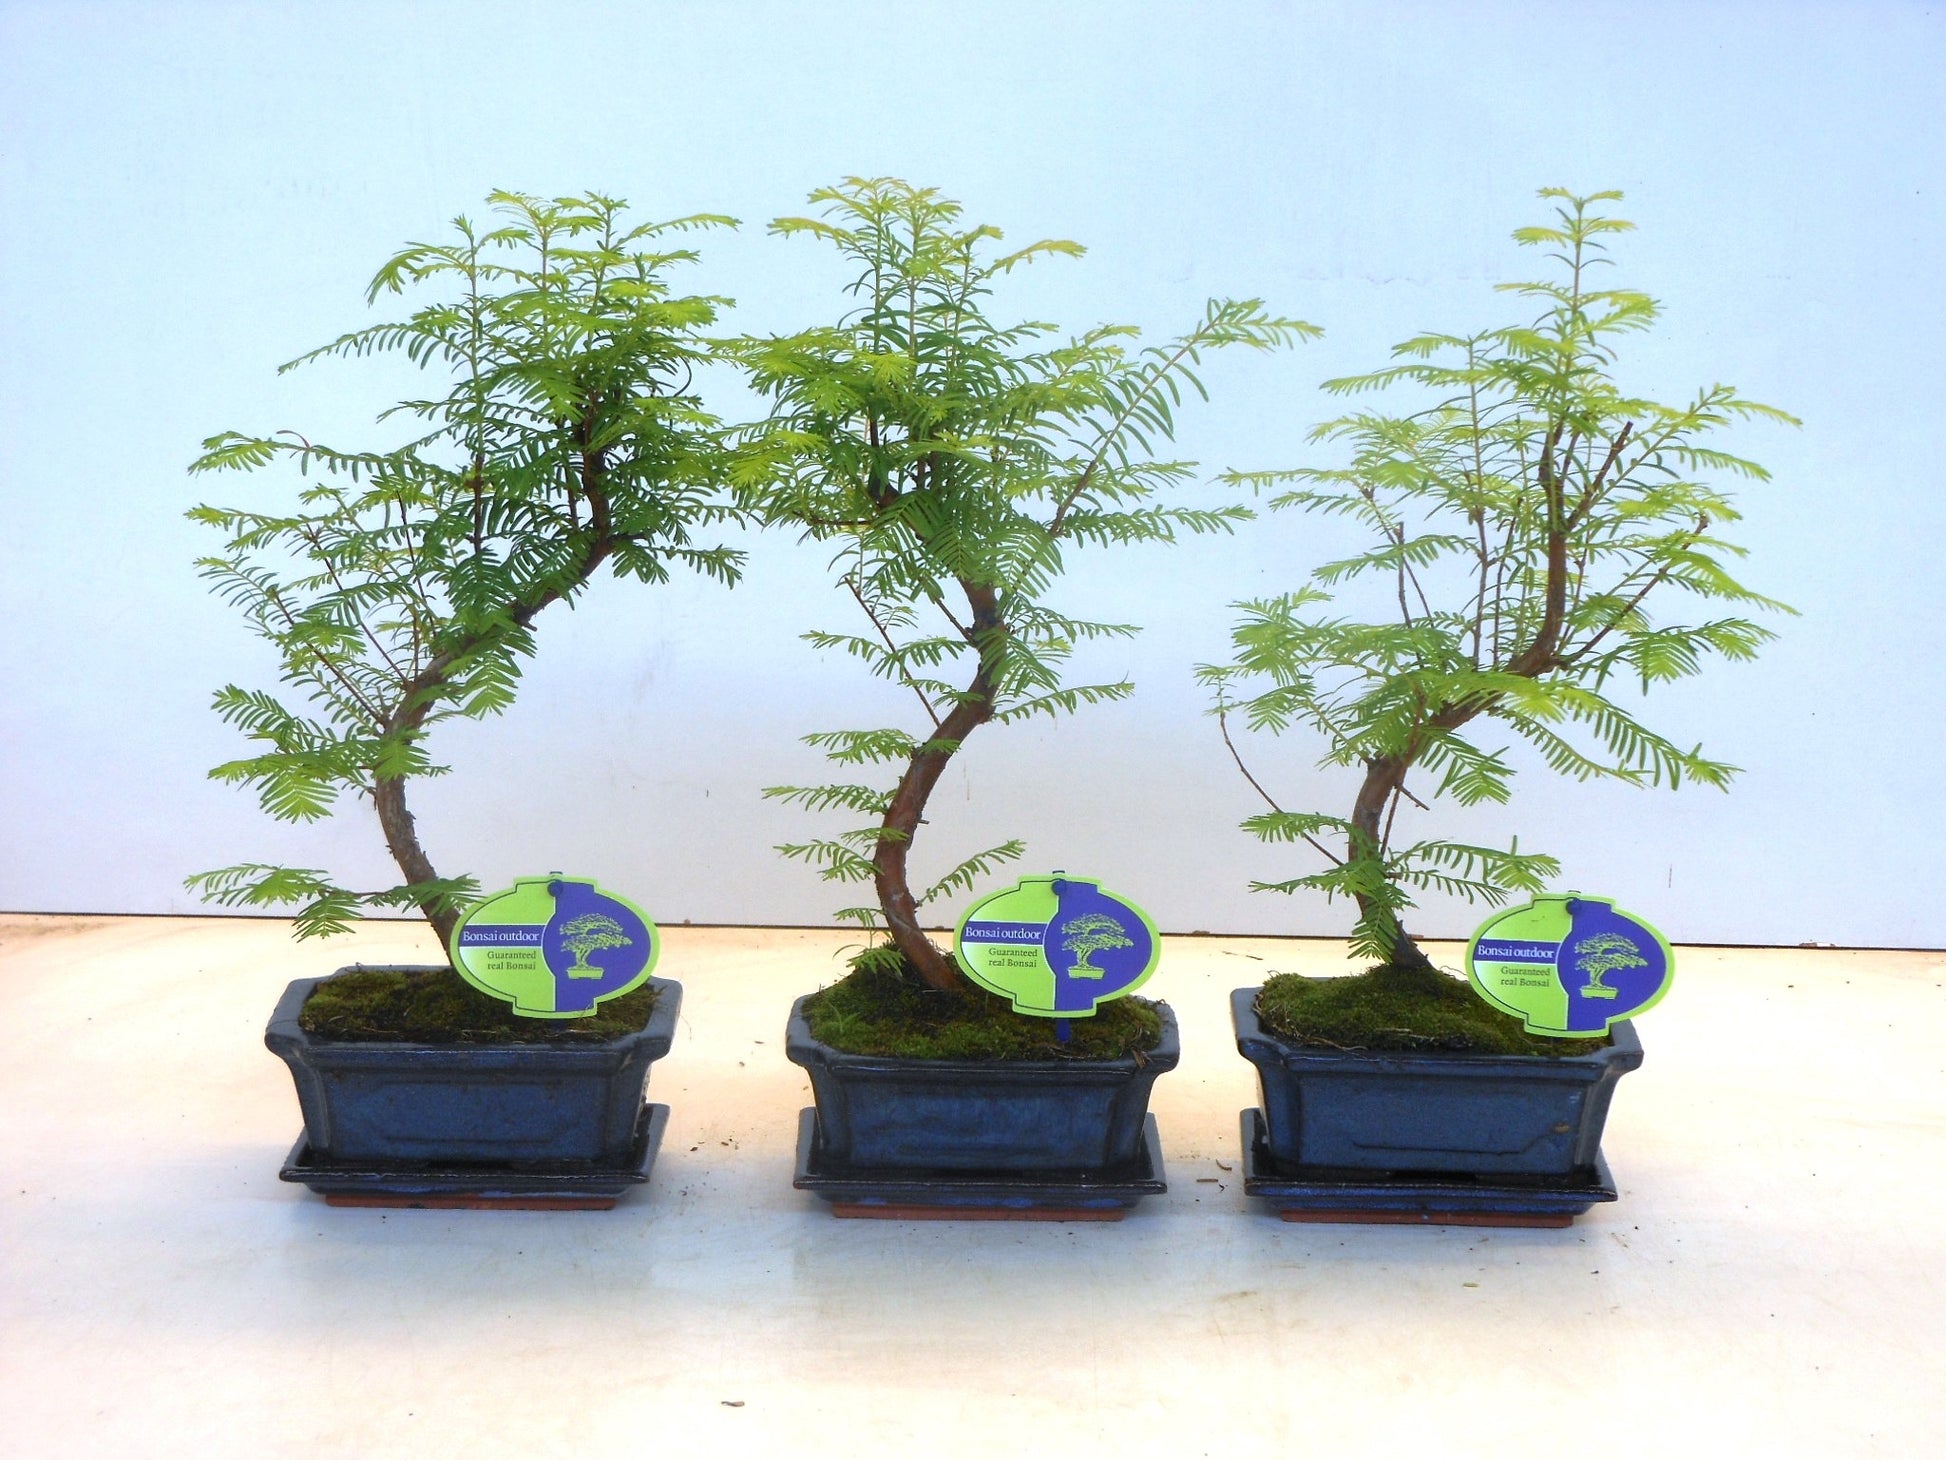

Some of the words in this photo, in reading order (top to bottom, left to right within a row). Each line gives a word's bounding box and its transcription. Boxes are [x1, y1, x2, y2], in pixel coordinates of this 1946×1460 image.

[463, 930, 498, 941] Bonsai
[499, 930, 539, 941] outdoor
[965, 926, 1000, 938] Bonsai
[1001, 928, 1041, 939] outdoor
[487, 951, 536, 959] Guaranteed
[988, 948, 1038, 957] Guaranteed
[1478, 944, 1513, 957] Bonsai
[1513, 947, 1554, 958] outdoor
[487, 962, 504, 970] real
[506, 962, 536, 970] Bonsai
[988, 958, 1005, 966] real
[1007, 959, 1037, 968] Bonsai
[1500, 966, 1551, 976] Guaranteed
[1500, 977, 1517, 986] real
[1519, 978, 1550, 987] Bonsai
